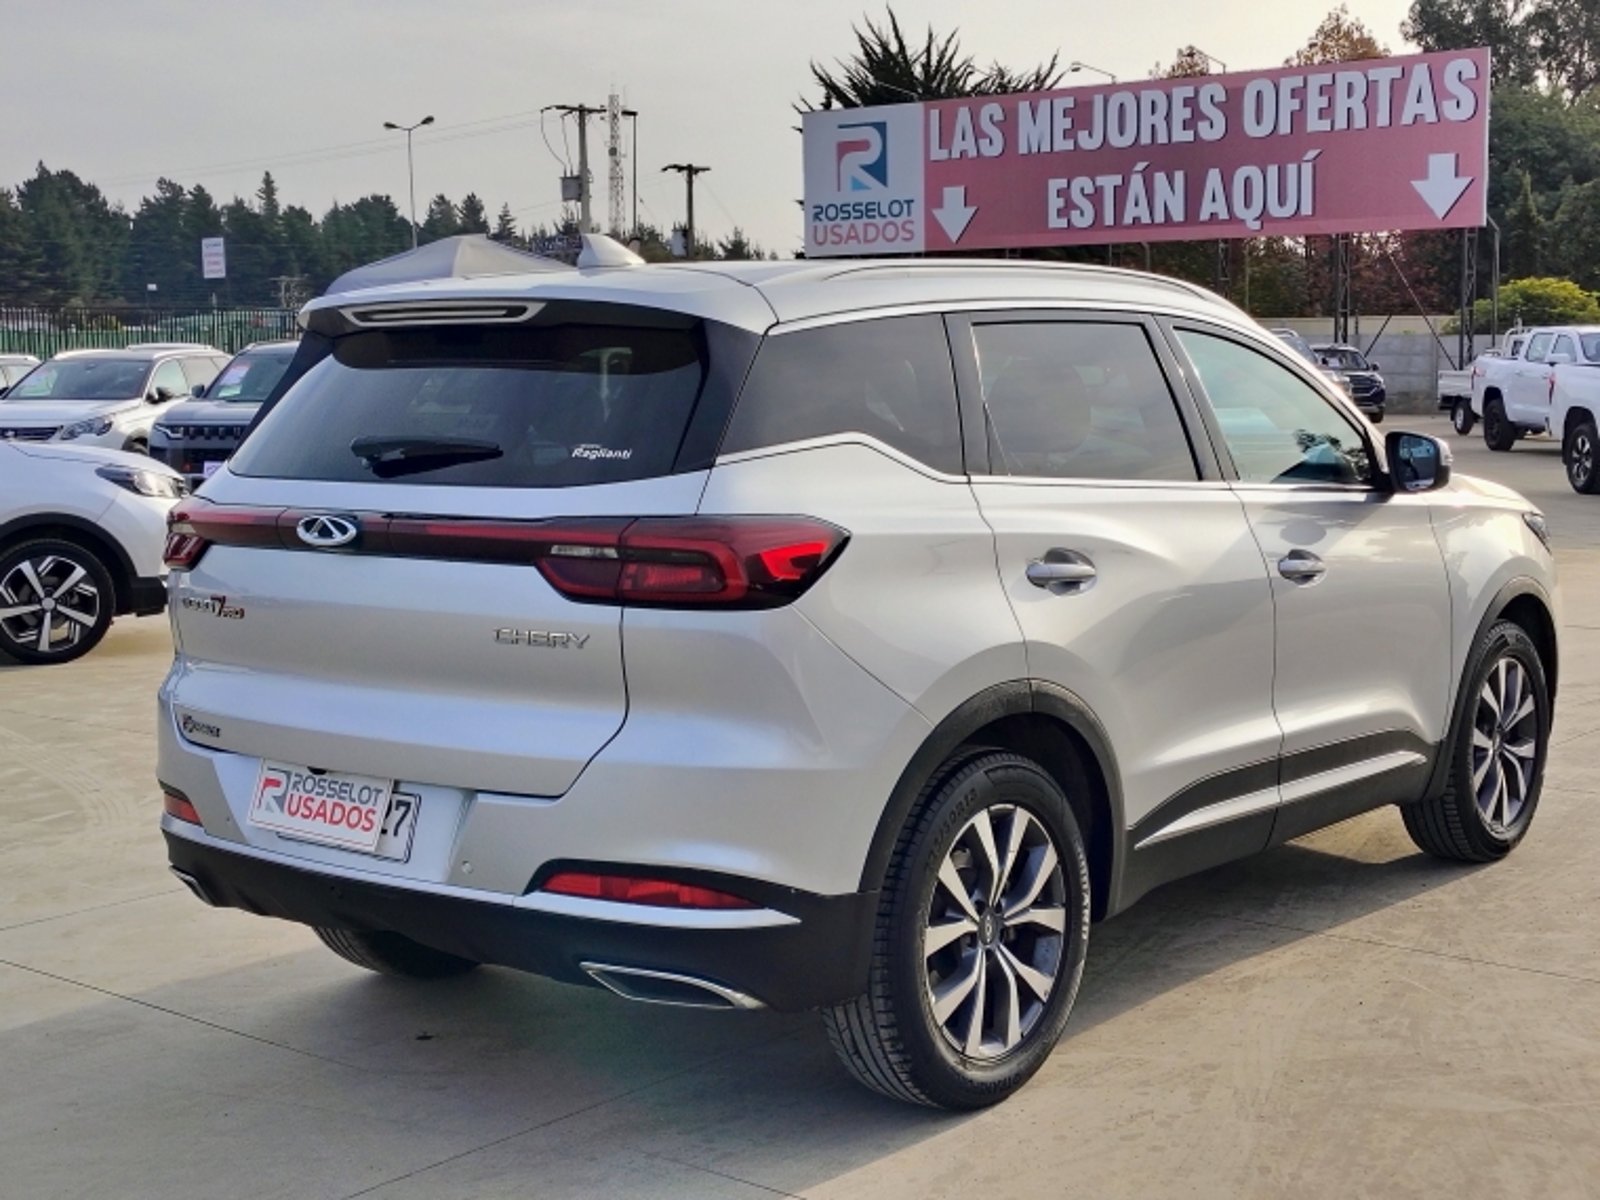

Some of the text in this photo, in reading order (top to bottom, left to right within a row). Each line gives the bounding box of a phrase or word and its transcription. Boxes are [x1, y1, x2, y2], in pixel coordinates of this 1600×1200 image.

[928, 58, 1479, 161] LAS MEJORES OFERTAS
[1047, 149, 1323, 231] ESTÁN AQUÍ
[812, 199, 915, 222] ROSSELOT
[813, 220, 915, 246] USADOS
[494, 629, 591, 649] CHERY
[291, 773, 384, 807] ROSSELOT
[287, 793, 376, 833] USADOS
